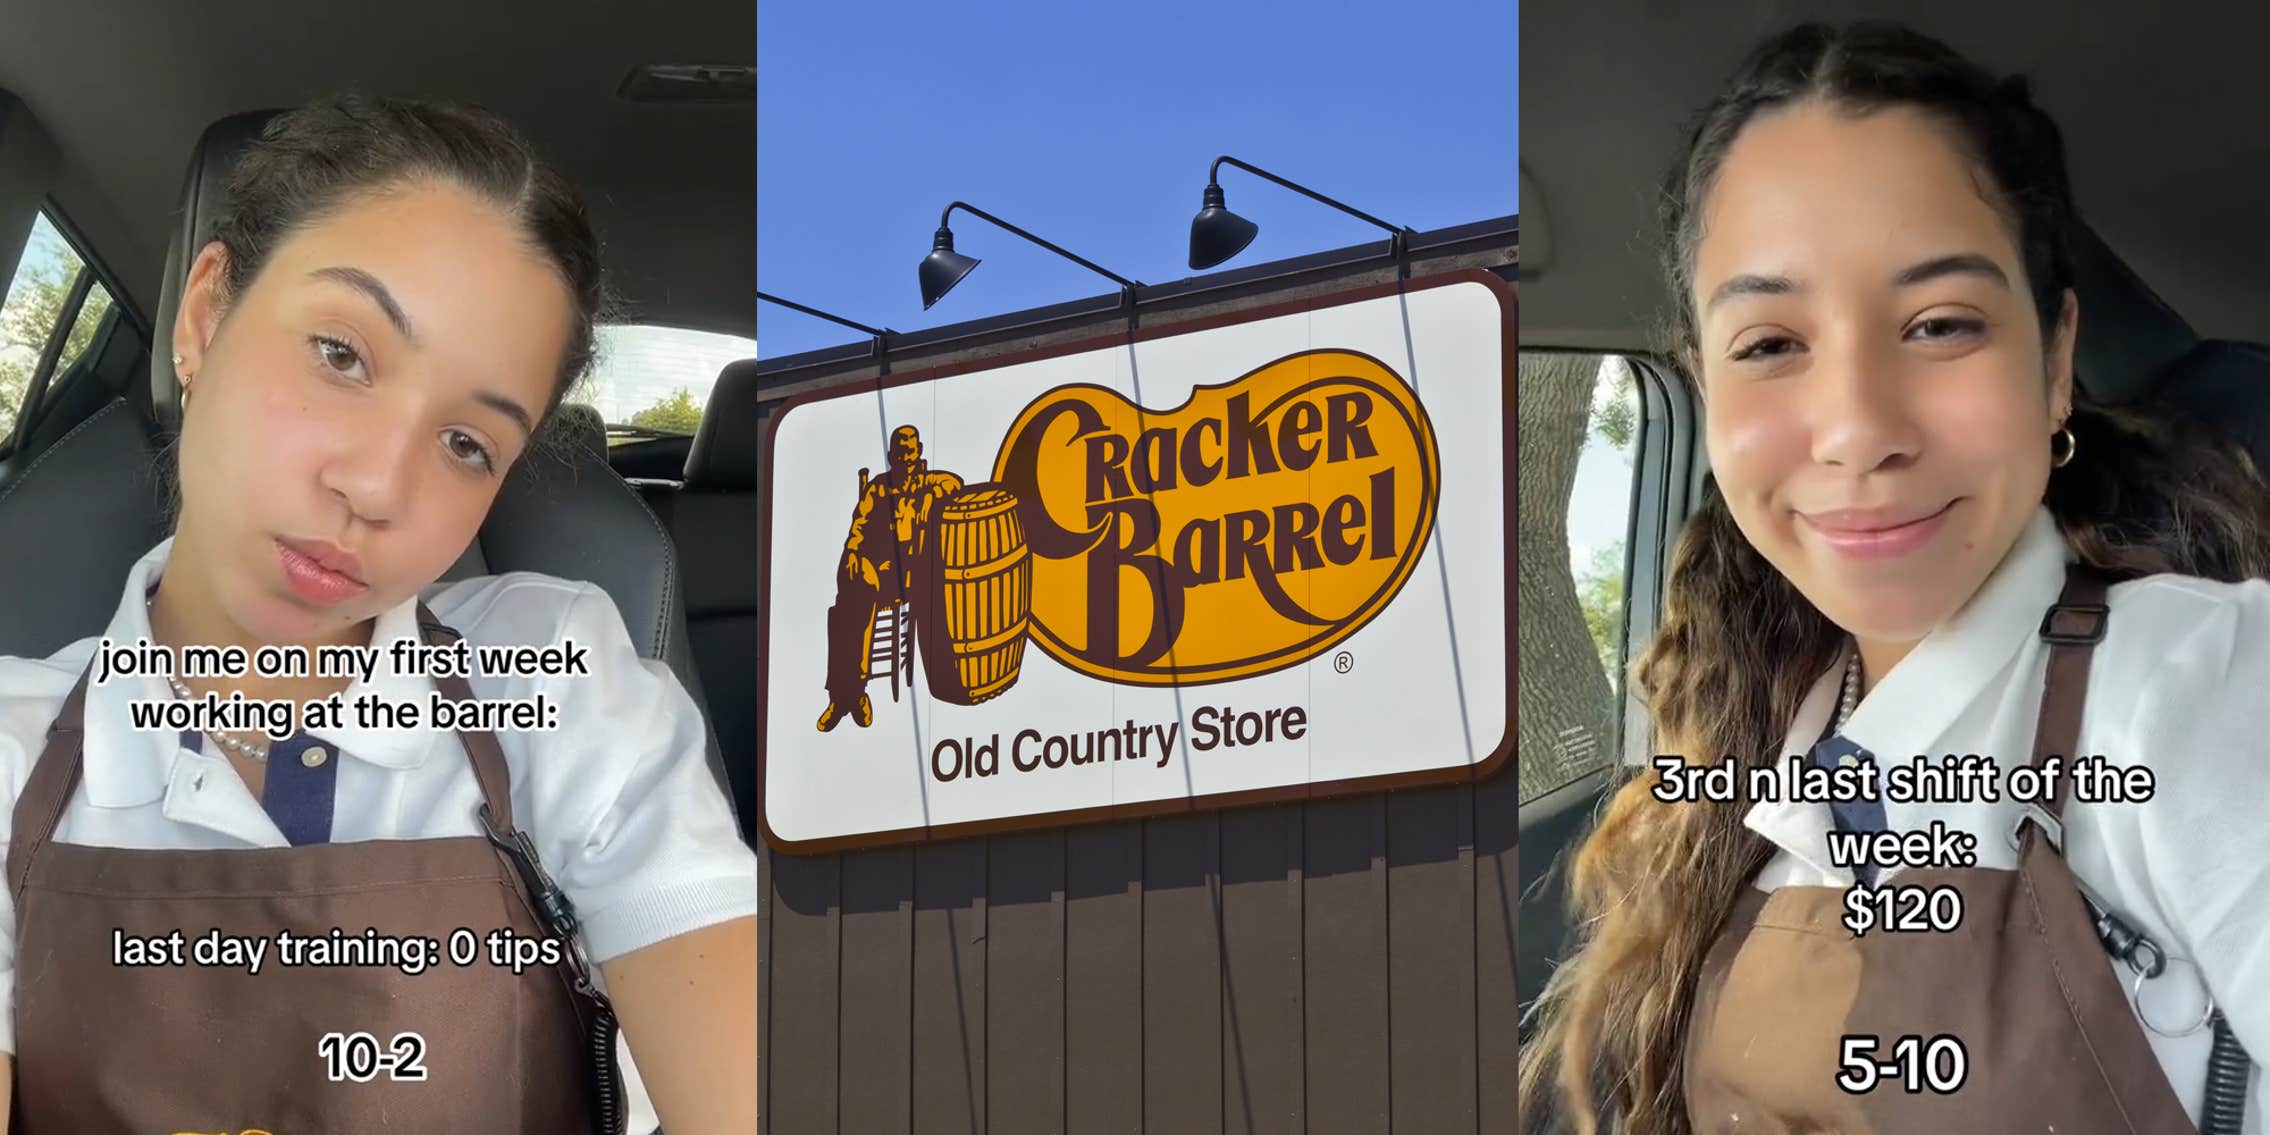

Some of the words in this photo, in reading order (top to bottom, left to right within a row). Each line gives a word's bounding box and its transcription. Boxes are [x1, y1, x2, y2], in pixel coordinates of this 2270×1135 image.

[931, 733, 1000, 783] Old
[1012, 719, 1179, 768] Country
[1191, 705, 1308, 752] Store
